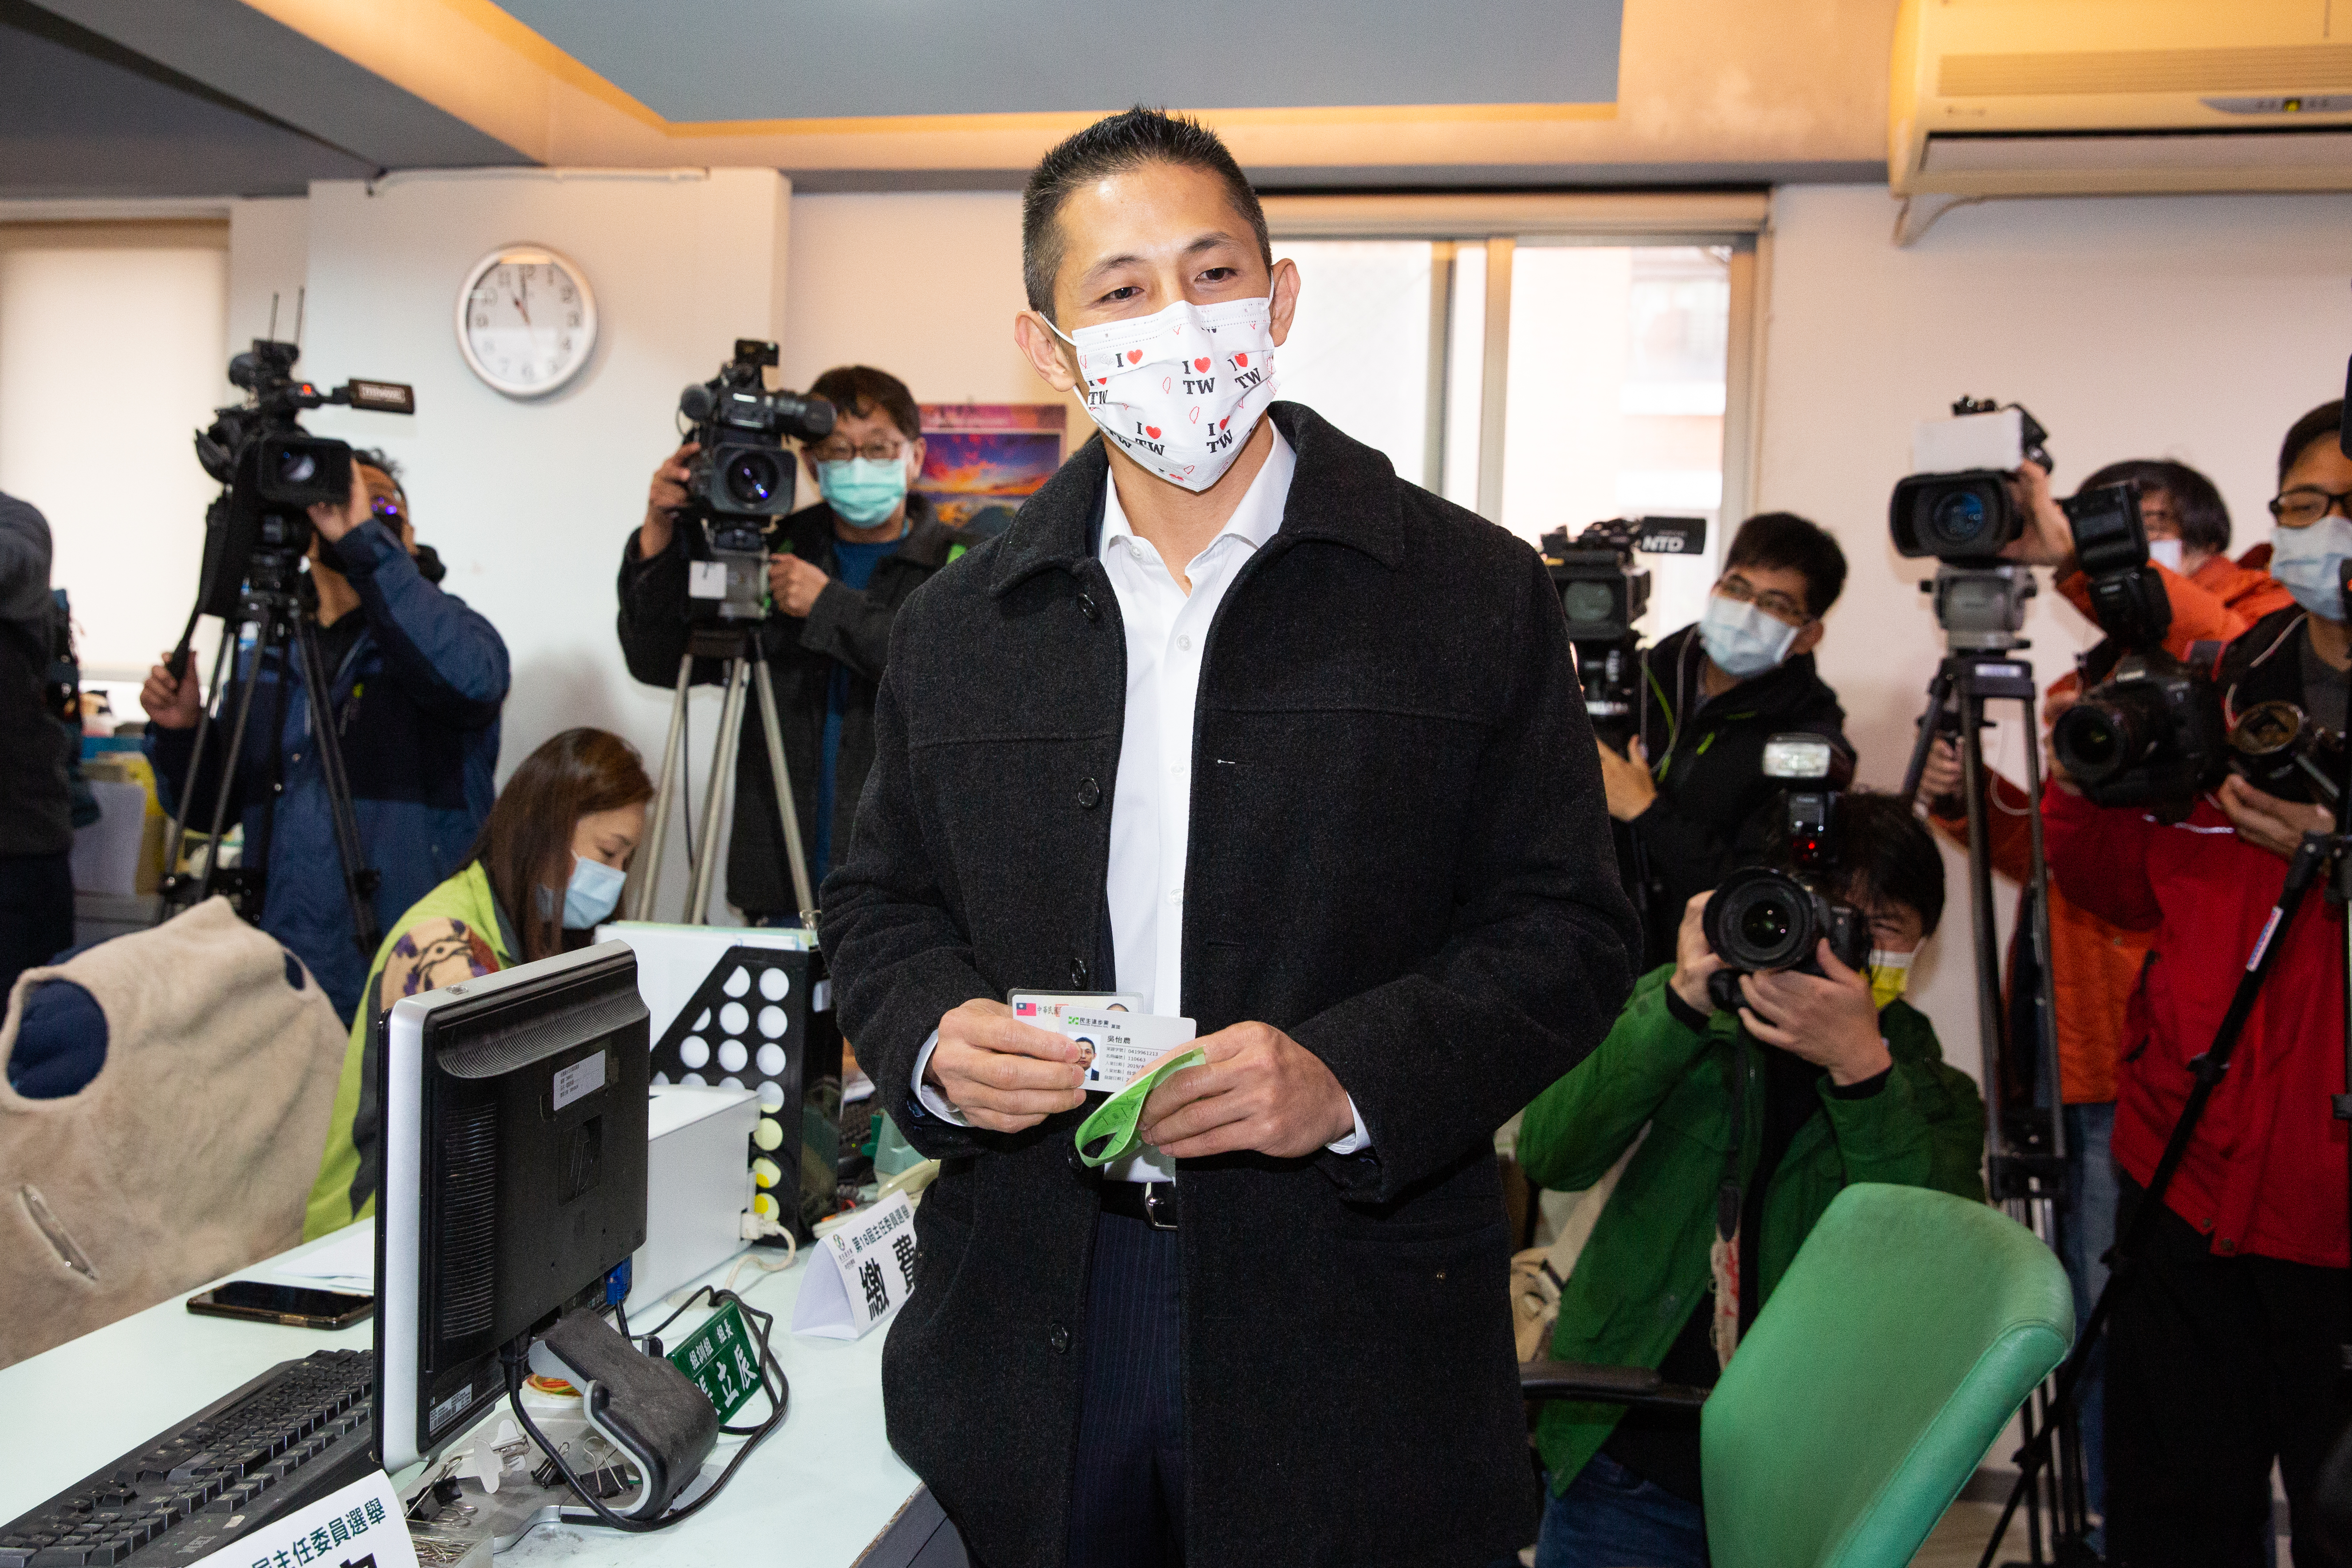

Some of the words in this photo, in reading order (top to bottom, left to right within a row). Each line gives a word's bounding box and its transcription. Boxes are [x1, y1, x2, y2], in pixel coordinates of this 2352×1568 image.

[1116, 353, 1124, 368] I
[1182, 360, 1191, 374] I
[1227, 359, 1237, 371] I
[1183, 377, 1215, 394] TW
[1234, 367, 1261, 389] TW
[1089, 390, 1108, 405] TW
[1136, 421, 1143, 435] I
[1207, 422, 1216, 437] I
[1207, 429, 1233, 453] TW
[1642, 535, 1685, 552] NTD
[1079, 1017, 1109, 1025] 民主進步黨
[1107, 1035, 1131, 1044] 吳怡農
[689, 1336, 714, 1371] 組訓組
[717, 1318, 734, 1344] 組長
